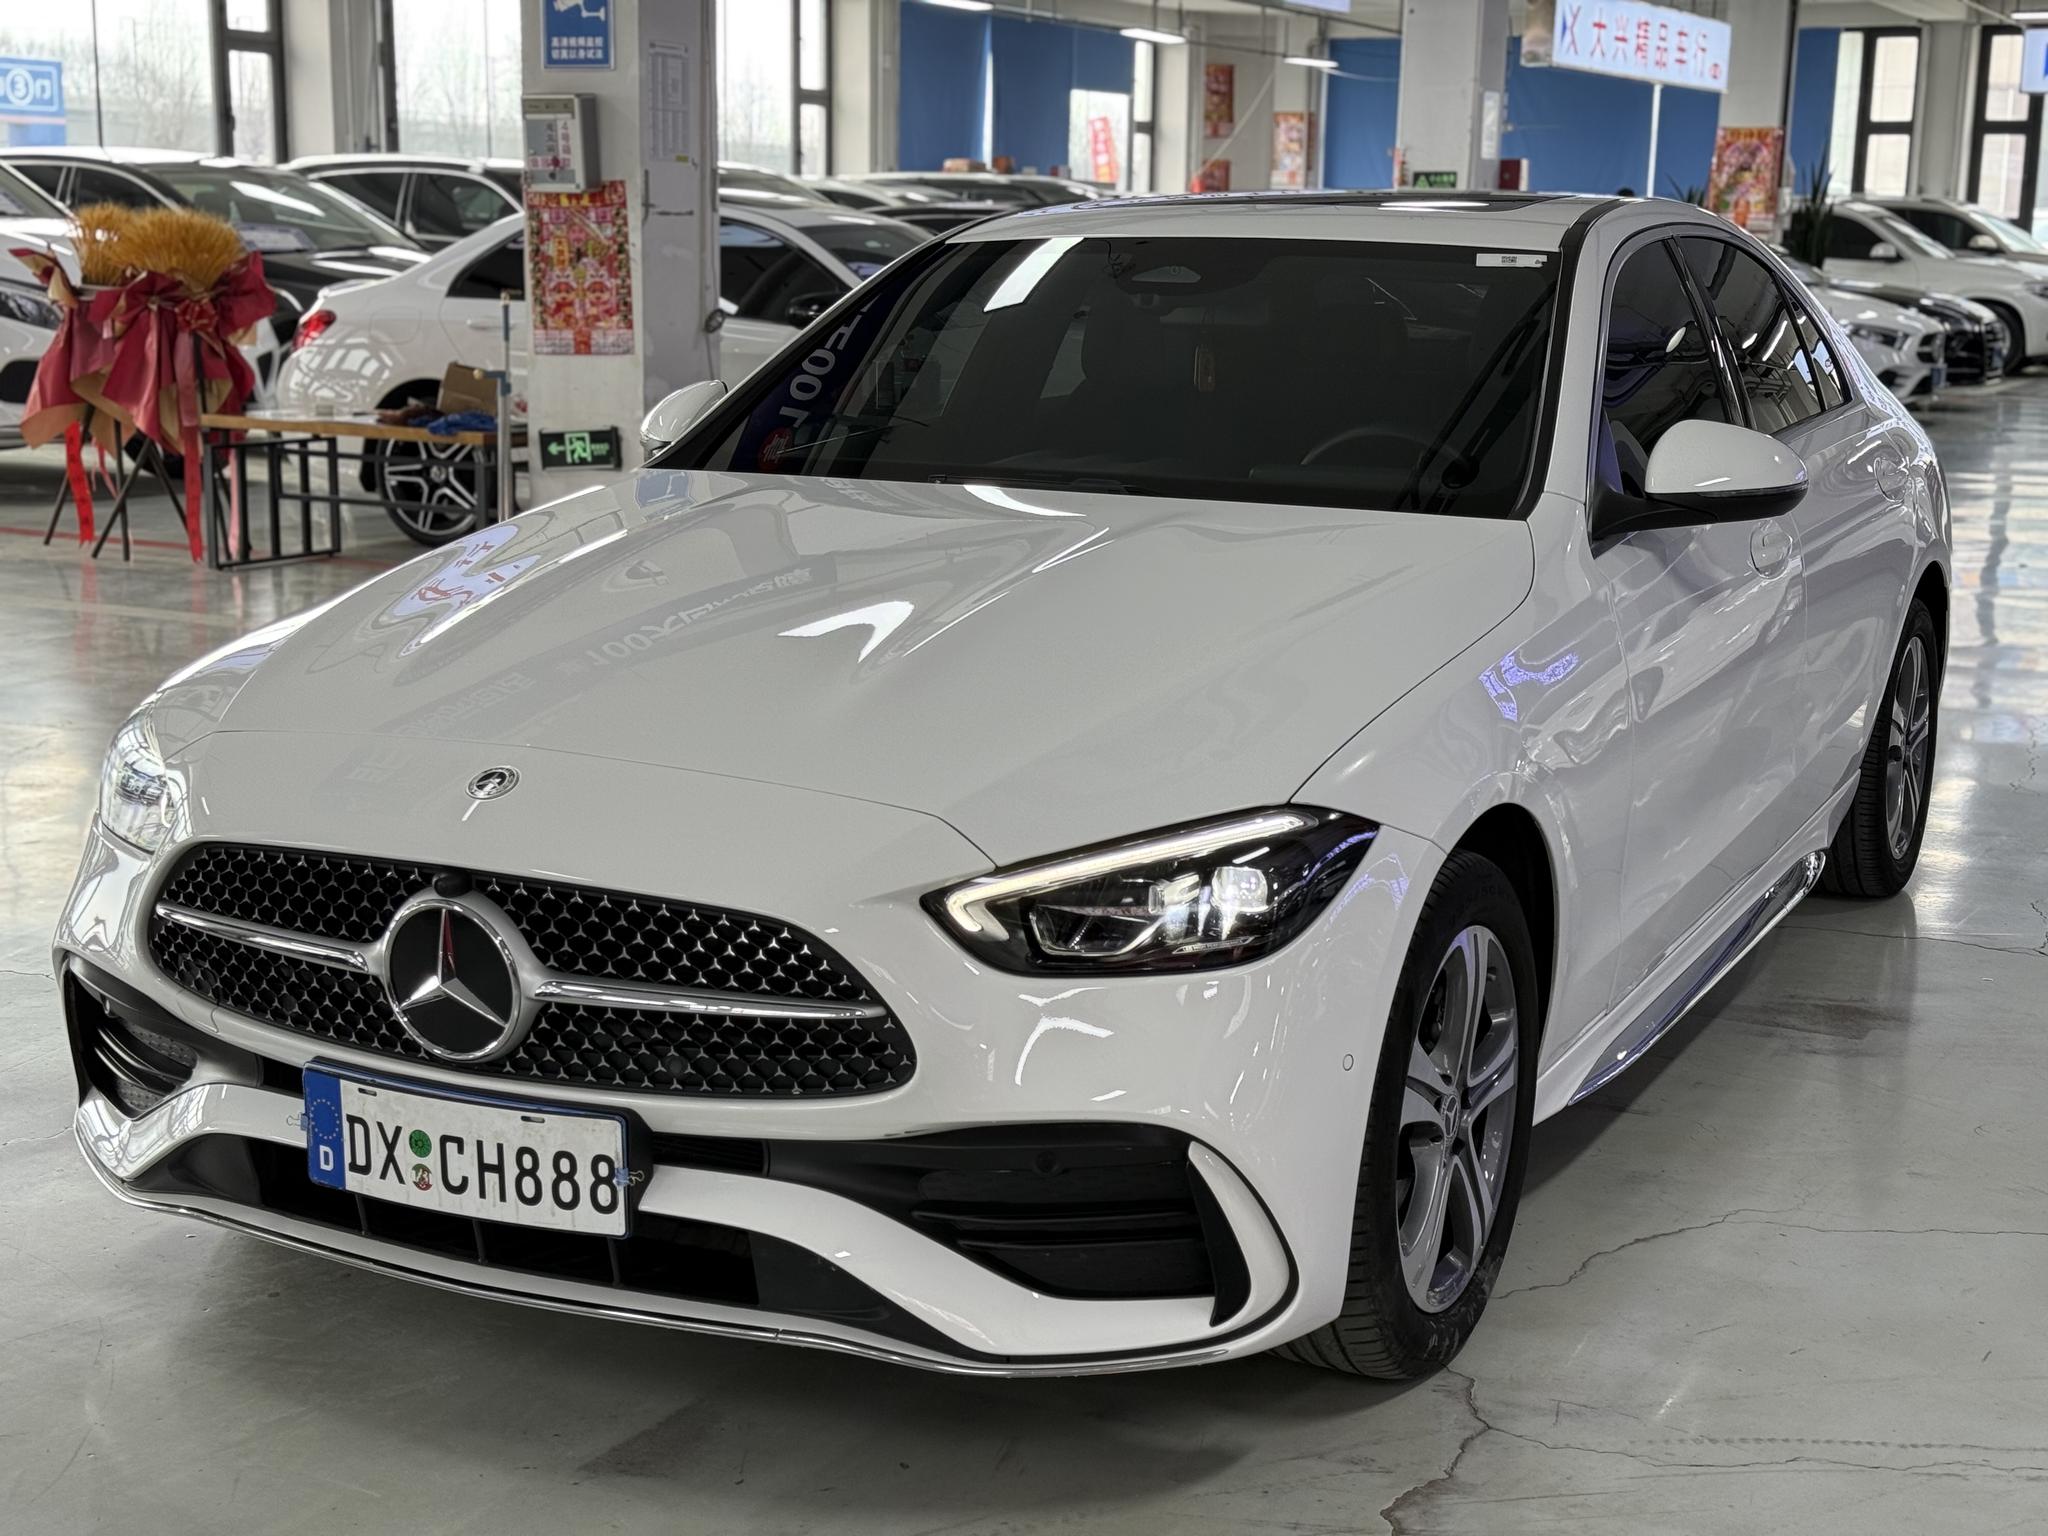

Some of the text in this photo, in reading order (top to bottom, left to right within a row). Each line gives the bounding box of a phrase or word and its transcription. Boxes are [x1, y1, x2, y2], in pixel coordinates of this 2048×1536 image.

[1590, 8, 1707, 78] 大兴精品车行
[319, 1145, 334, 1171] D
[346, 1113, 619, 1215] DX CH888
